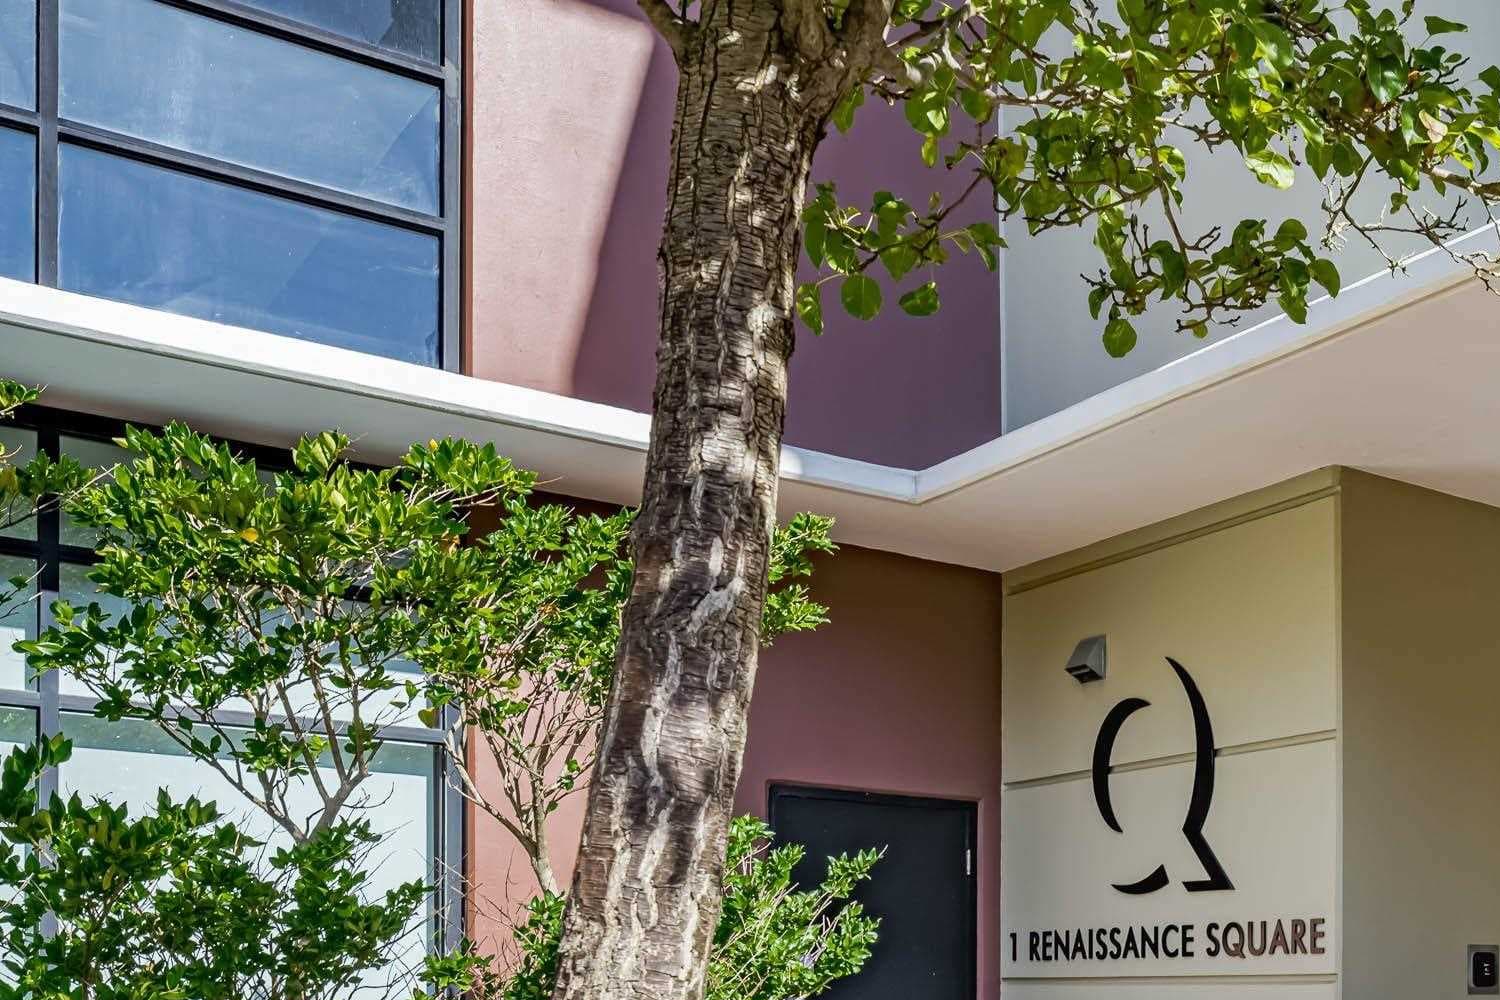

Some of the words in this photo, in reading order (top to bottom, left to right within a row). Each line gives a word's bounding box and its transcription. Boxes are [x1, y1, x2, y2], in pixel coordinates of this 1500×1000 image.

[1009, 932, 1018, 962] 1
[1029, 924, 1194, 962] RENAISSANCE
[1206, 918, 1325, 959] SQUARE
